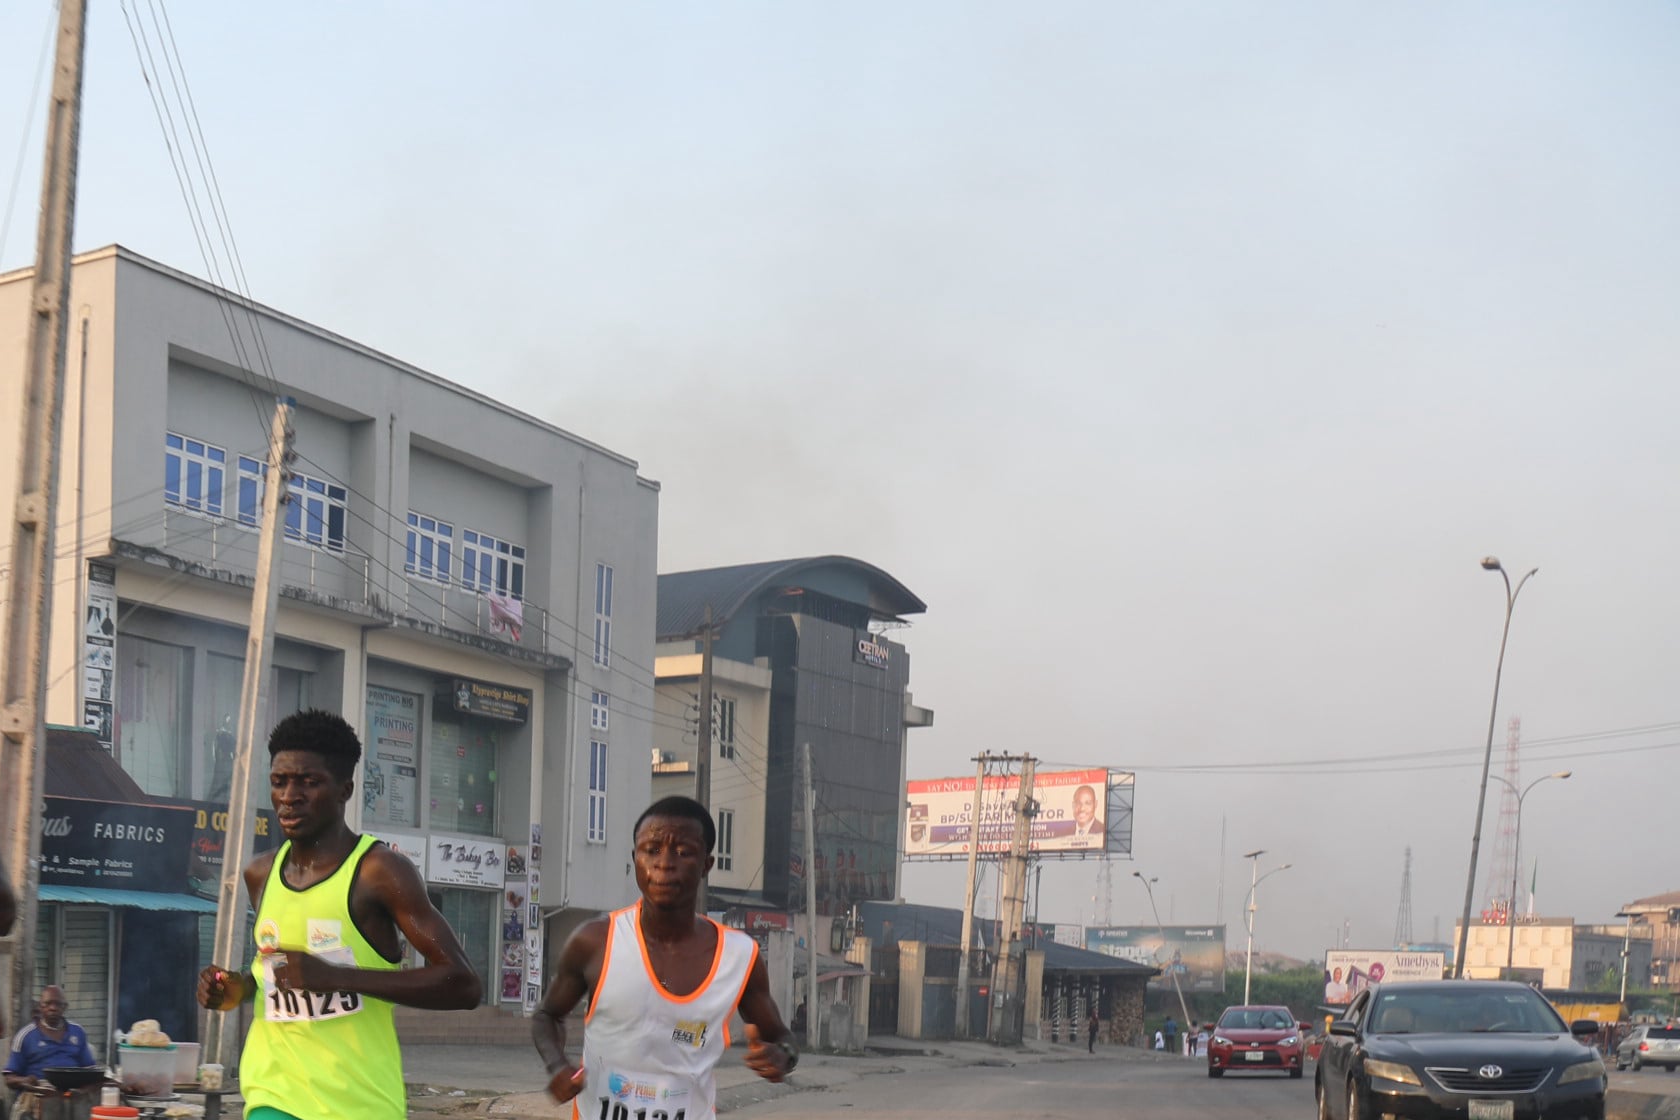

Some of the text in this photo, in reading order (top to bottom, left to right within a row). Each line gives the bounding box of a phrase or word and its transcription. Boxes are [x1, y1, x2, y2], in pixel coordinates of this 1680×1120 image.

[368, 690, 401, 704] PRINTING
[374, 716, 414, 733] PRINTING
[944, 781, 963, 792] NO!
[1004, 809, 1065, 822] MTOR
[93, 822, 166, 844] FABRICS
[68, 857, 100, 867] Sample
[104, 858, 134, 868] Fabrics
[1395, 953, 1440, 970] Amethyst
[269, 987, 360, 1018] 10125
